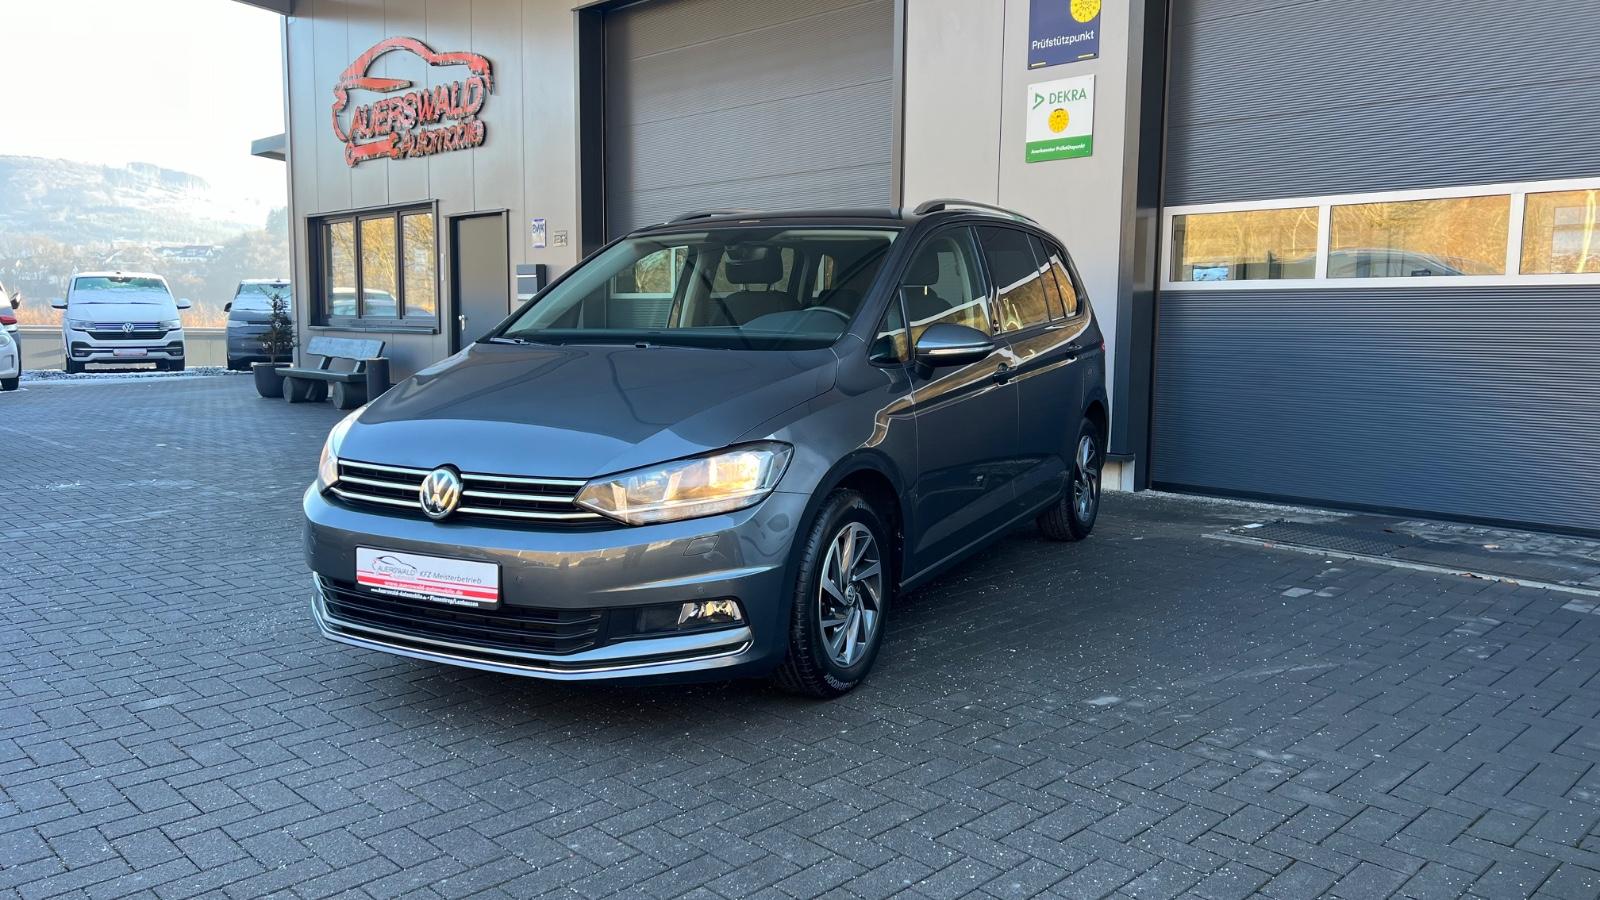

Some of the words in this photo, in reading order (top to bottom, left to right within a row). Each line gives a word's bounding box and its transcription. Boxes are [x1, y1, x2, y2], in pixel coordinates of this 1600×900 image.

[1031, 29, 1095, 50] Prüfstützpunkt
[1048, 87, 1087, 105] DEKRA
[350, 76, 485, 142] AUERSWALD
[420, 571, 482, 584] KFZ-Meisterbetrieb
